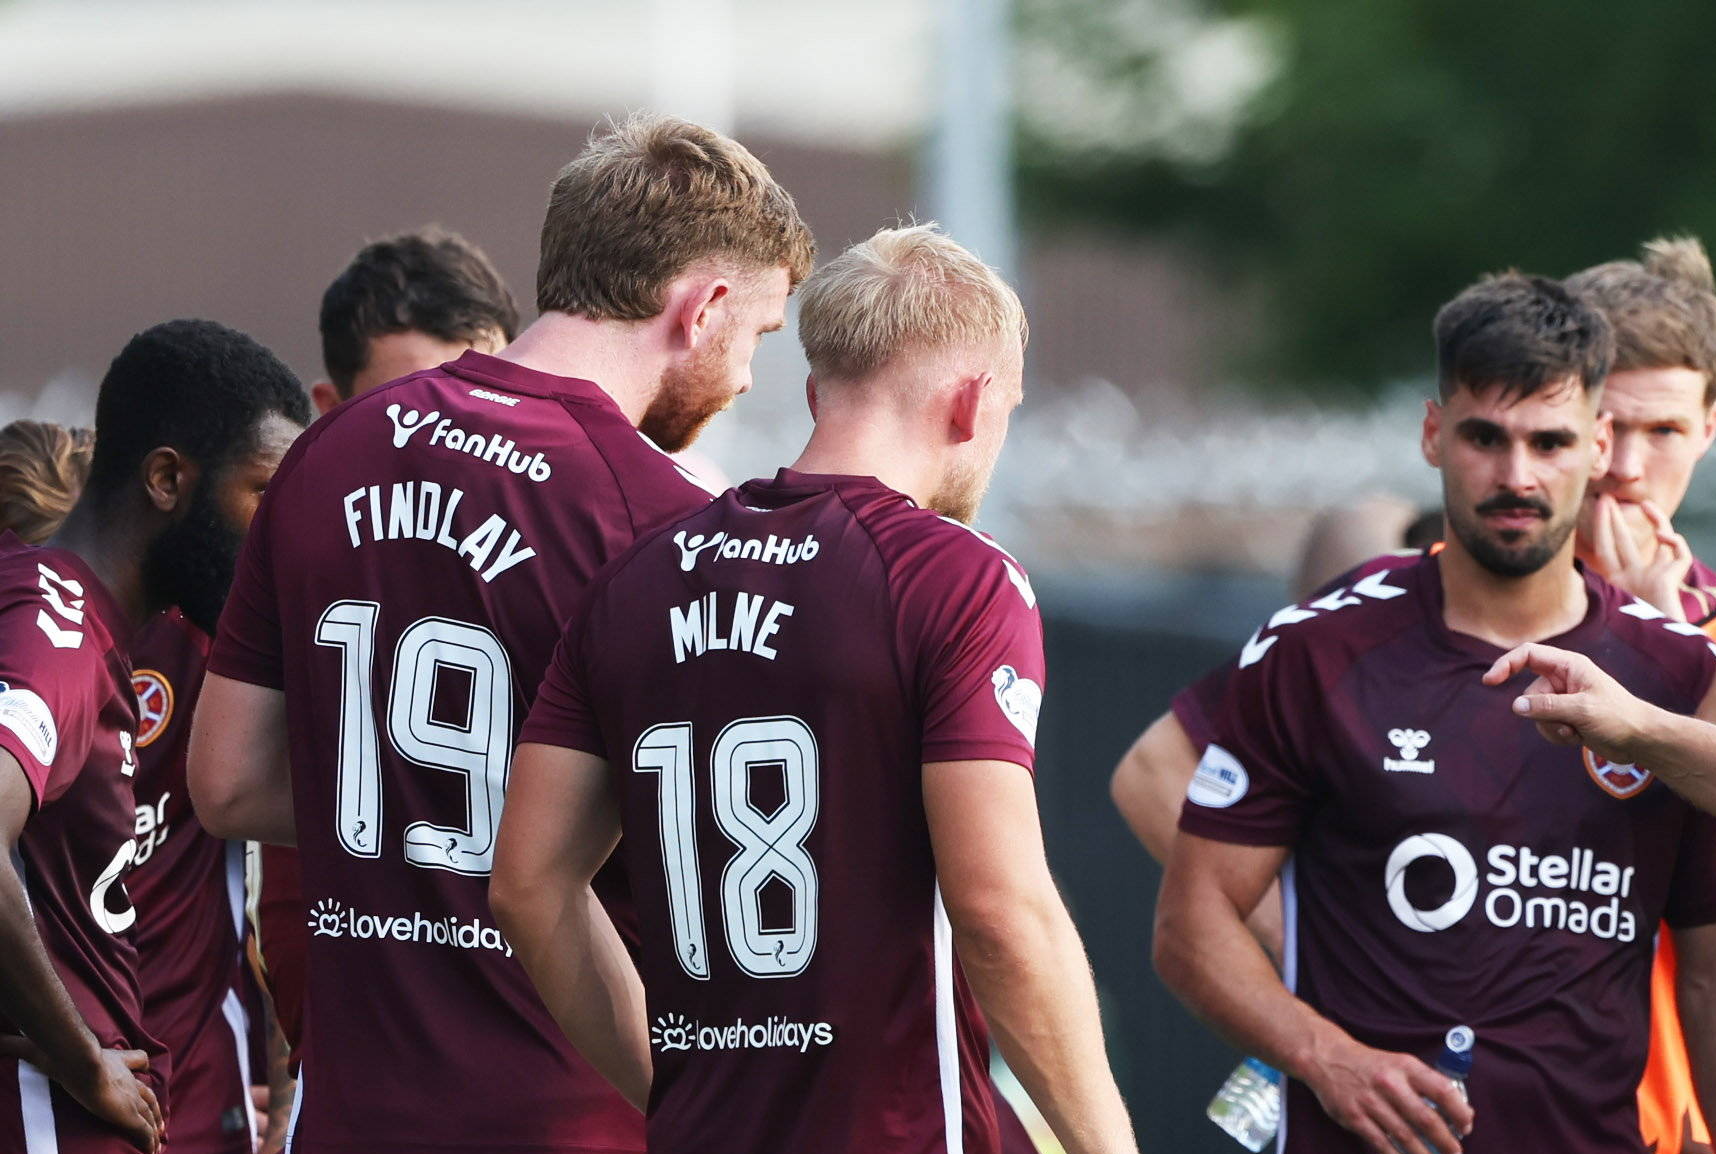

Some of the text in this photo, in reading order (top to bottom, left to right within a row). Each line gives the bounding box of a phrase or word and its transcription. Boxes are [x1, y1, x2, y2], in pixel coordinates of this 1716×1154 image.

[343, 480, 537, 584] FINDLAY
[315, 599, 513, 877] 19
[632, 714, 820, 981] 18
[1486, 844, 1635, 898] Stellar
[1485, 887, 1636, 943] Omada
[696, 1005, 834, 1053] loveholidays
